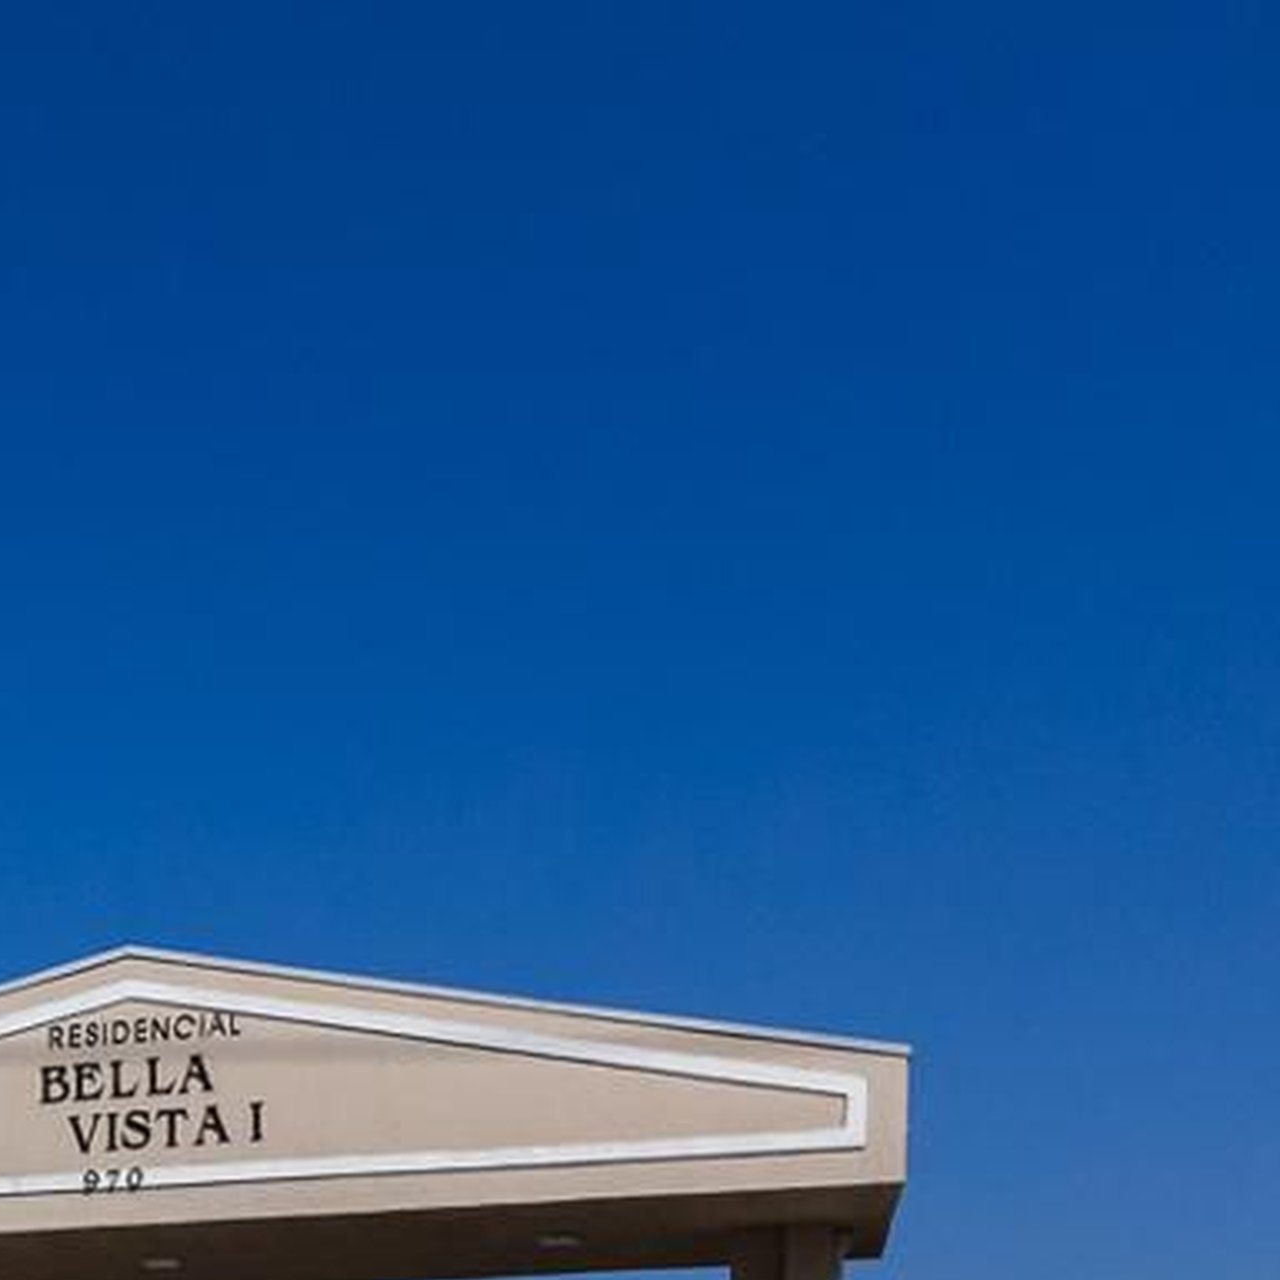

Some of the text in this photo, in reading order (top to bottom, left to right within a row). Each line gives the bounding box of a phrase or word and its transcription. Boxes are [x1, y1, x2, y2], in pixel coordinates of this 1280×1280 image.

[48, 1013, 241, 1050] RESIDENCIAL
[40, 1054, 214, 1104] BELLA
[68, 1104, 230, 1154] VISTA
[83, 1167, 144, 1196] 970
